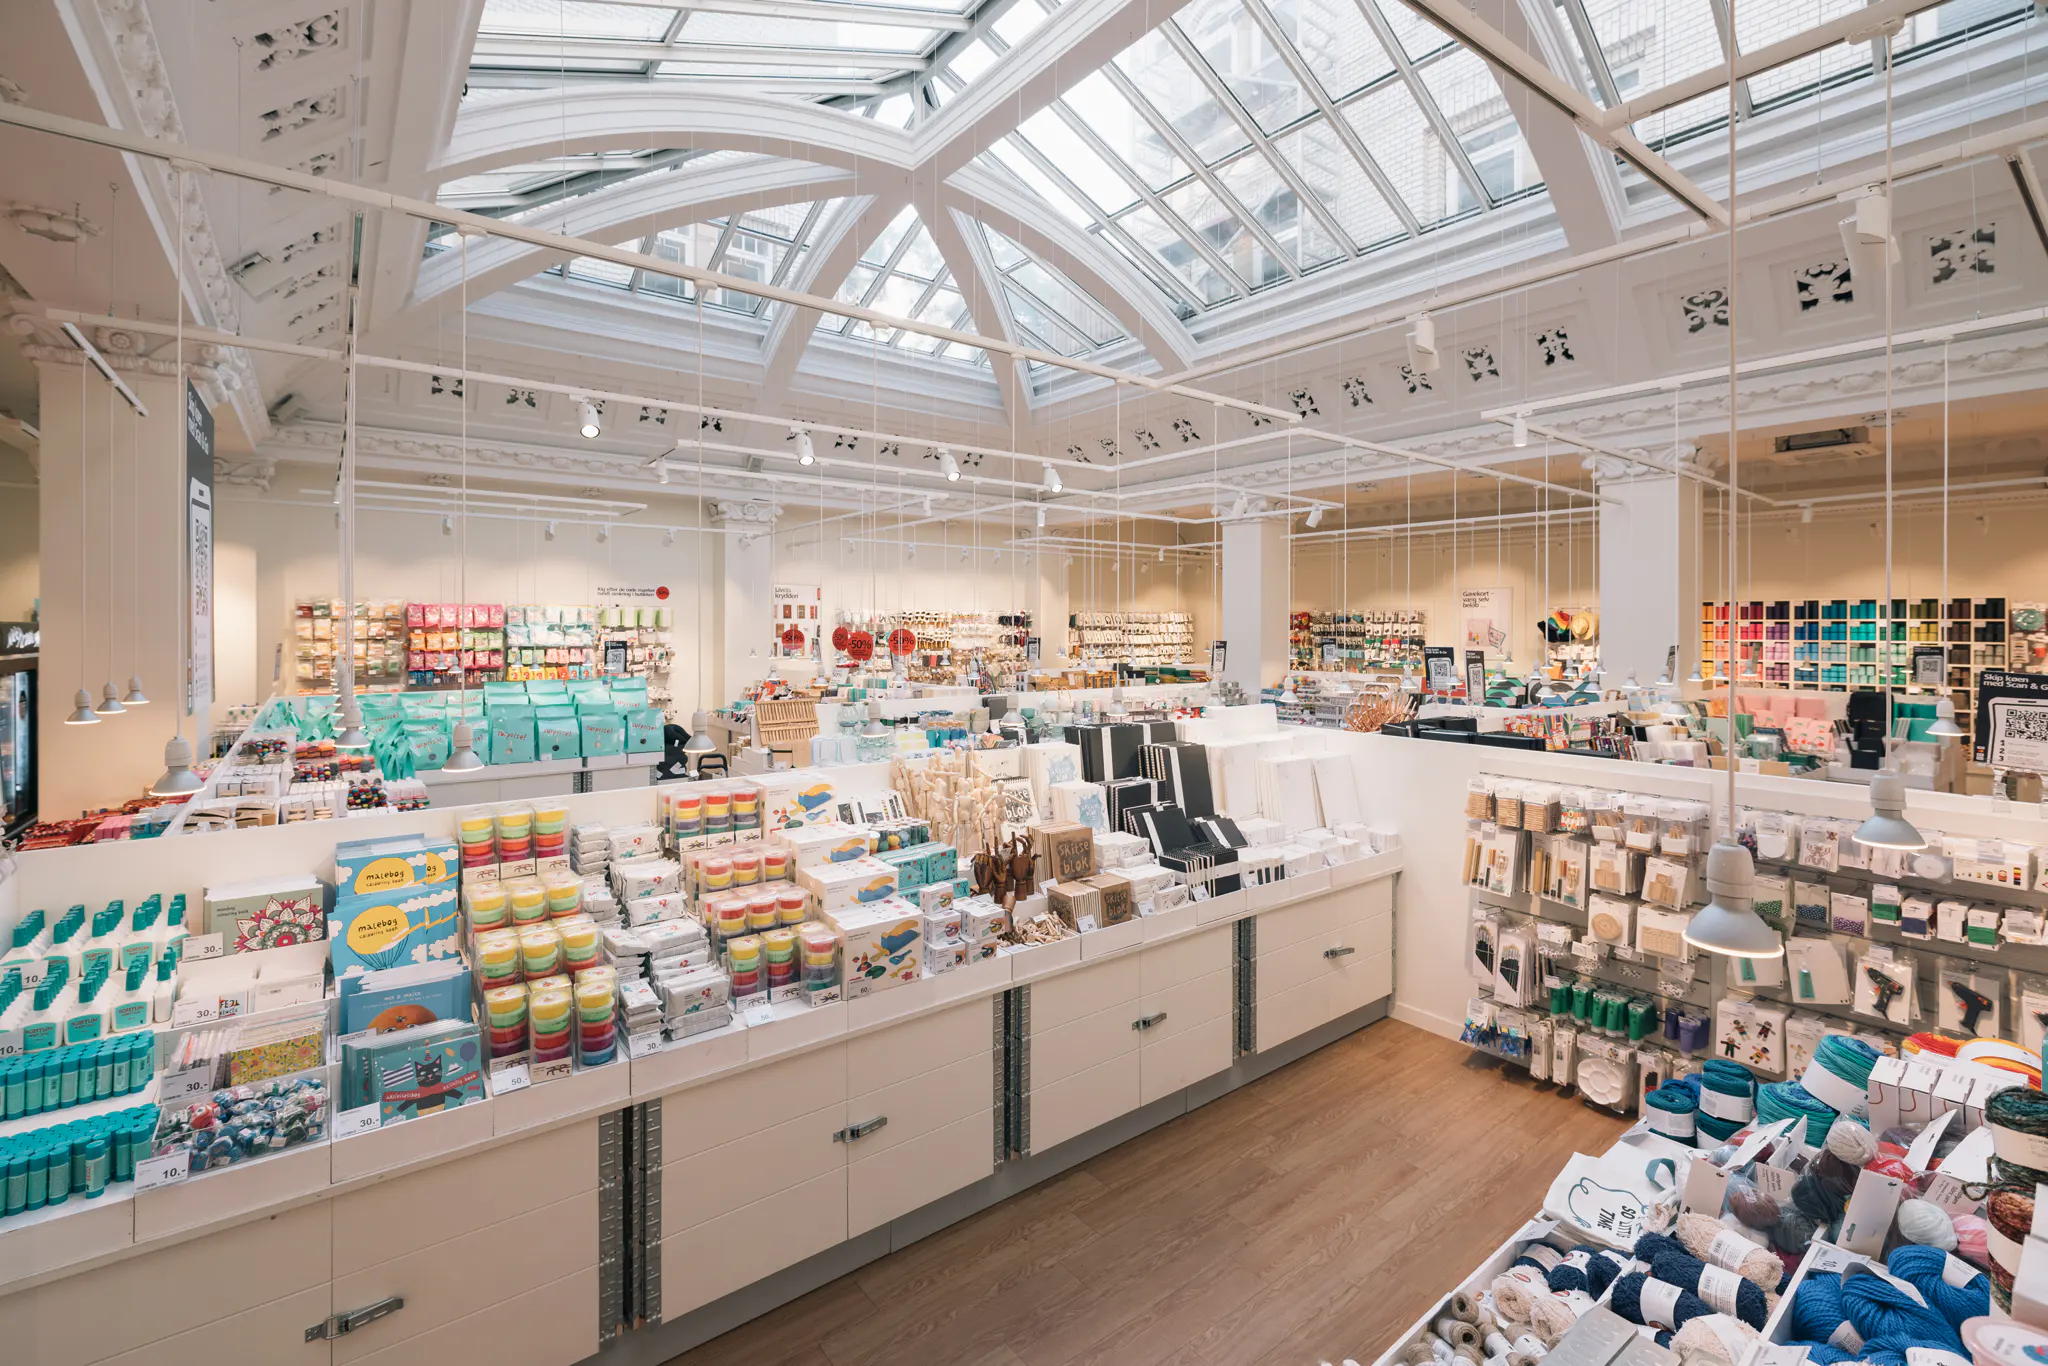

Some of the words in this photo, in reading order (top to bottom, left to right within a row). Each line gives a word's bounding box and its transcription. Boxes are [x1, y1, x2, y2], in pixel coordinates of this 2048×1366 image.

[848, 640, 871, 649] -50%
[586, 725, 612, 734] surprise!
[632, 722, 657, 731] surprise!
[497, 731, 527, 740] surprise!
[544, 728, 571, 738] surprise!
[366, 871, 404, 880] malebog
[358, 919, 398, 932] malebog
[359, 931, 383, 939] colouring
[204, 946, 222, 954] 30.-
[197, 1010, 216, 1018] 30.-
[511, 1077, 528, 1085] 50.-
[186, 1082, 208, 1092] 30.-
[360, 1118, 380, 1128] 30.-
[163, 1168, 186, 1179] 10.-
[1622, 1205, 1636, 1220] SO
[1597, 1208, 1615, 1231] TIME
